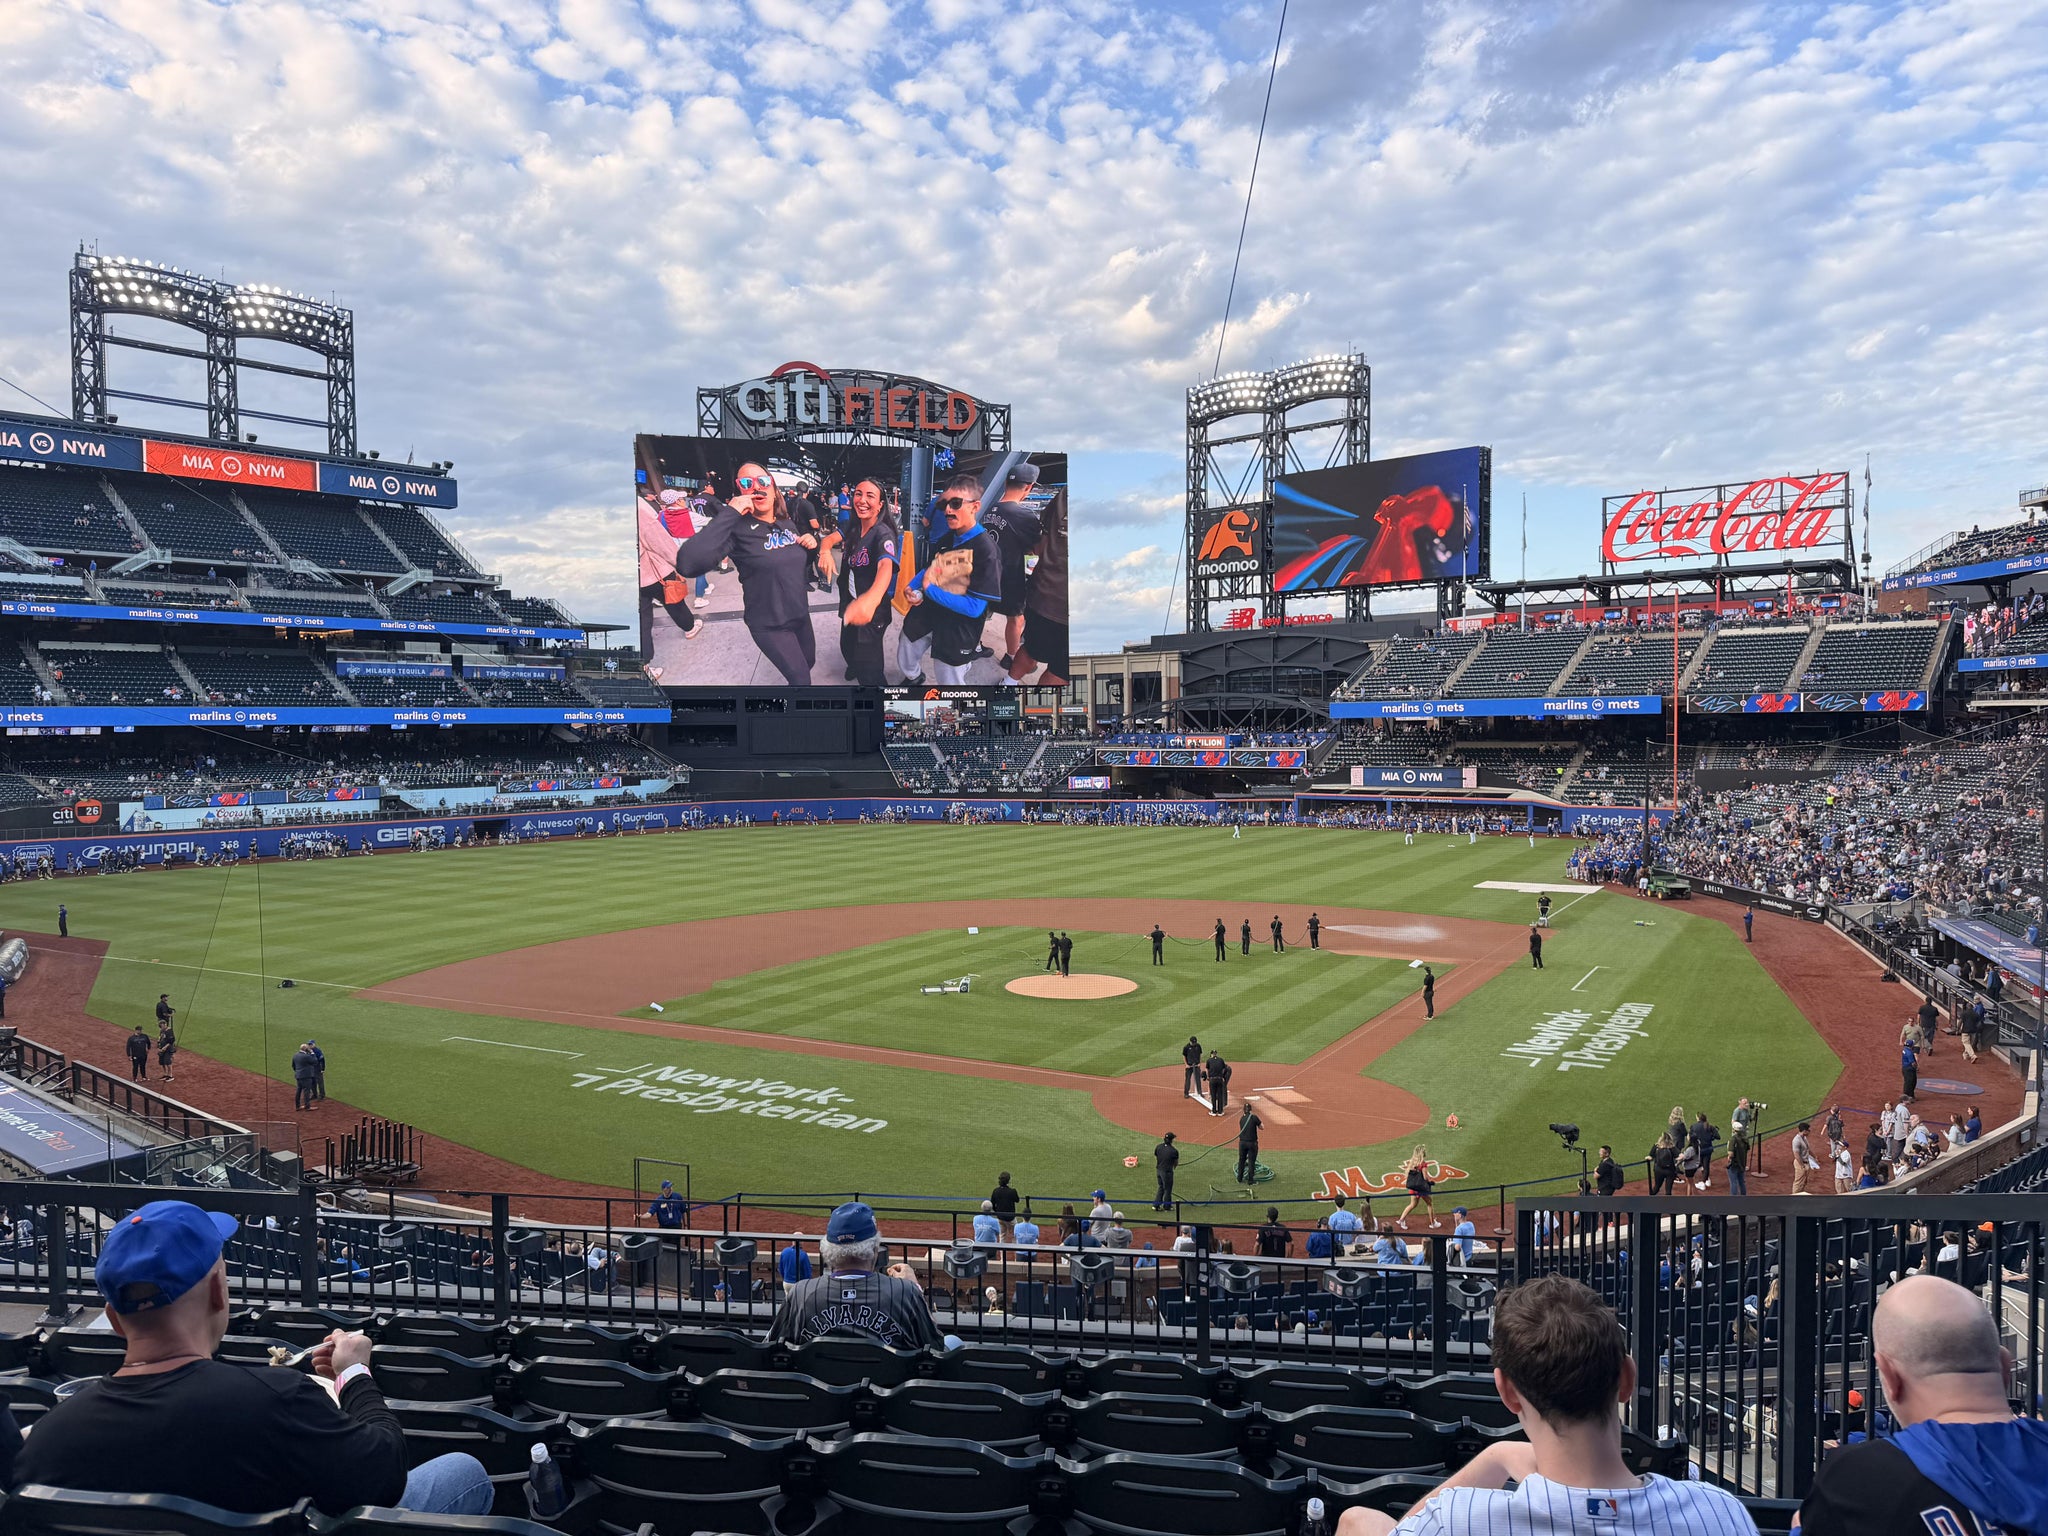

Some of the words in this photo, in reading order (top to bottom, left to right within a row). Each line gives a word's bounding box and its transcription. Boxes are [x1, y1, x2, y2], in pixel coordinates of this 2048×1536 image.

[738, 372, 829, 424] citi
[844, 386, 977, 430] FIELD
[62, 439, 106, 457] NYM
[182, 454, 214, 470] MIA
[249, 462, 285, 479] NYM
[349, 475, 376, 490] MIA
[405, 482, 437, 497] NYM
[1602, 471, 1849, 562] Coca-Cola
[842, 547, 870, 567] ets
[1198, 559, 1259, 575] moomoo
[2006, 558, 2032, 570] marlins
[1941, 571, 1957, 580] mets
[30, 605, 56, 613] mets
[129, 609, 162, 618] marlins
[176, 612, 199, 620] mets
[263, 616, 292, 624] marlins
[304, 618, 324, 626] mets
[380, 621, 407, 629] marlins
[1258, 617, 1281, 627] new
[1284, 613, 1333, 627] balance
[1983, 657, 2007, 668] marlins
[2018, 656, 2037, 667] mets
[365, 667, 396, 675] MILAGRO
[1382, 702, 1419, 713] marlins
[1436, 702, 1464, 713] mets
[1543, 699, 1588, 711] marlins
[1607, 699, 1640, 710] mets
[189, 711, 231, 721] marlins
[249, 712, 277, 721] mets
[394, 711, 429, 720] marlins
[443, 712, 466, 720] mets
[564, 711, 593, 720] marlins
[605, 712, 624, 720] mets
[1381, 772, 1400, 781] MIA
[1419, 772, 1443, 782] NYM
[53, 808, 73, 820] citi
[86, 806, 99, 816] 26
[216, 807, 243, 818] Coors
[790, 806, 804, 814] 408
[538, 819, 573, 829] Invesco
[291, 830, 334, 840] NewYok-
[1561, 1002, 1655, 1062] Presbyterian
[594, 1078, 888, 1133] Presbyterian
[1312, 1160, 1470, 1202] Mes
[800, 1304, 902, 1345] ALVAREZ
